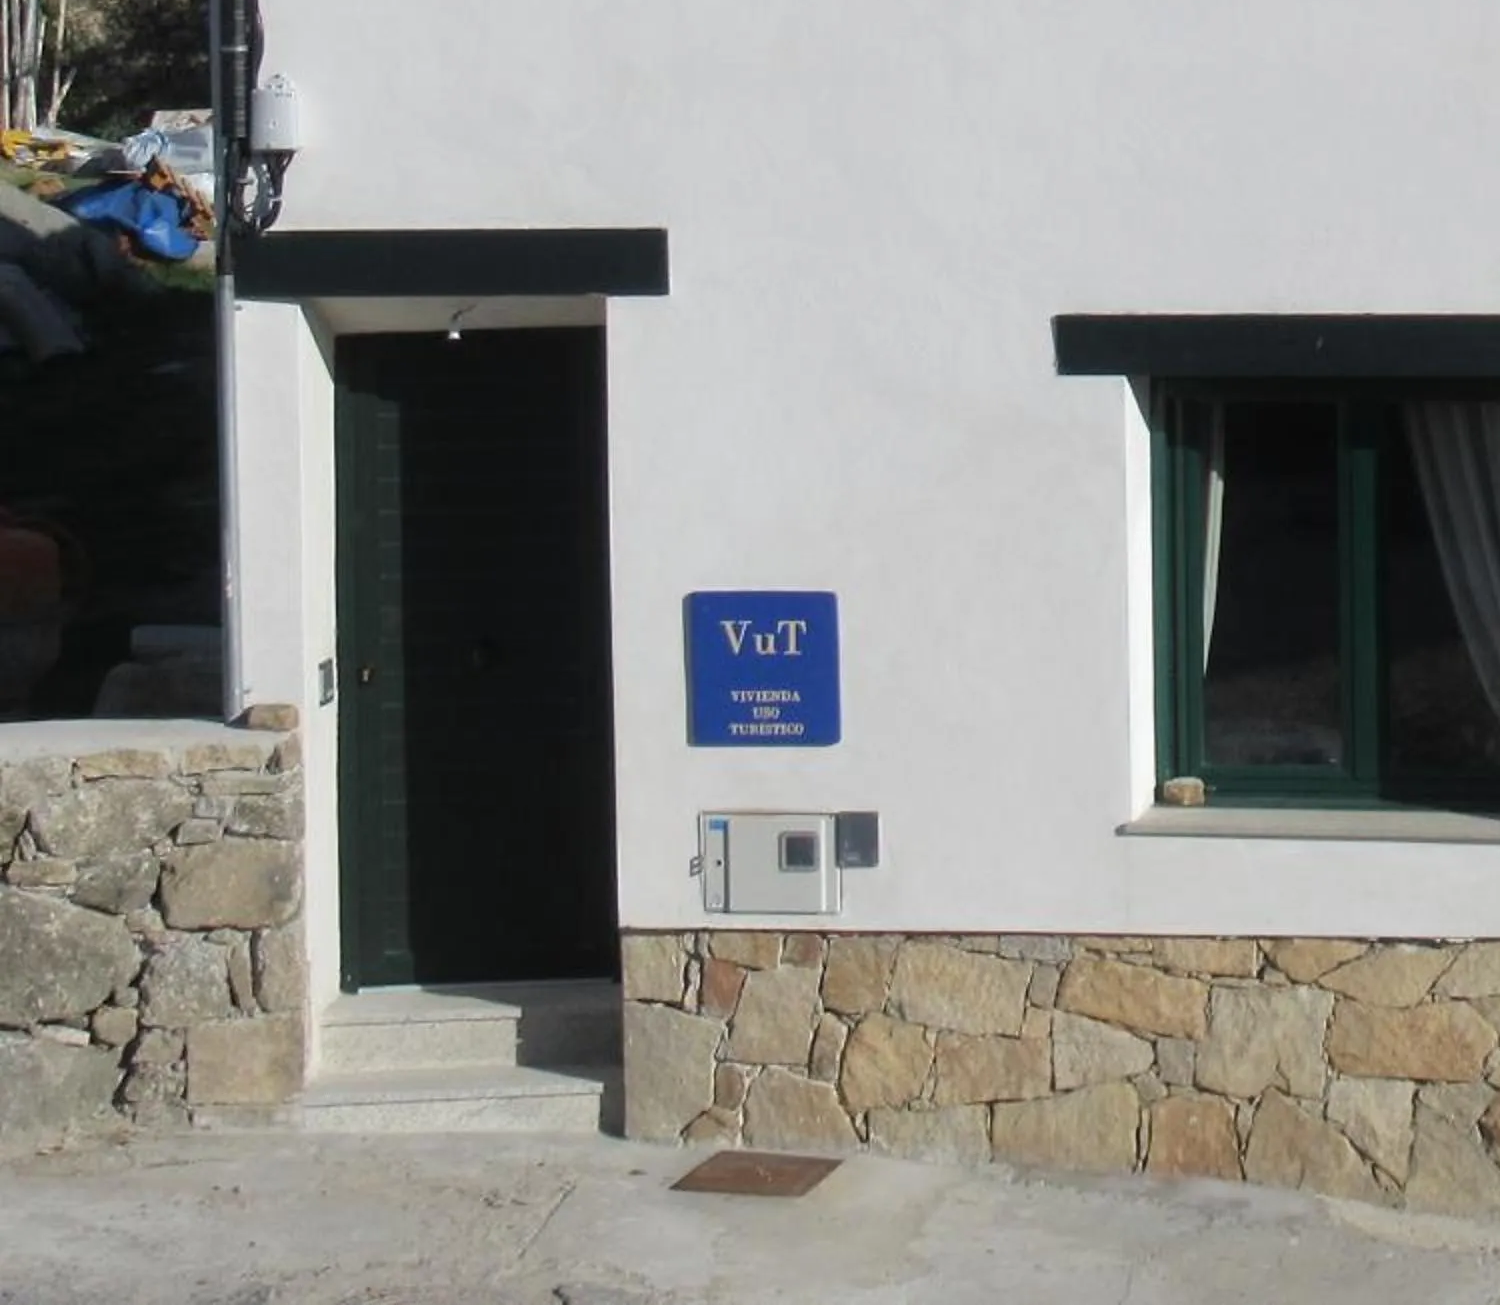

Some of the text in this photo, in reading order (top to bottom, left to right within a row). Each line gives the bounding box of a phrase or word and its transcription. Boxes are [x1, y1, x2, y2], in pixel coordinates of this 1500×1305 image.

[720, 619, 808, 656] VuT
[730, 690, 801, 703] VIVIENDA
[752, 706, 780, 720] USO
